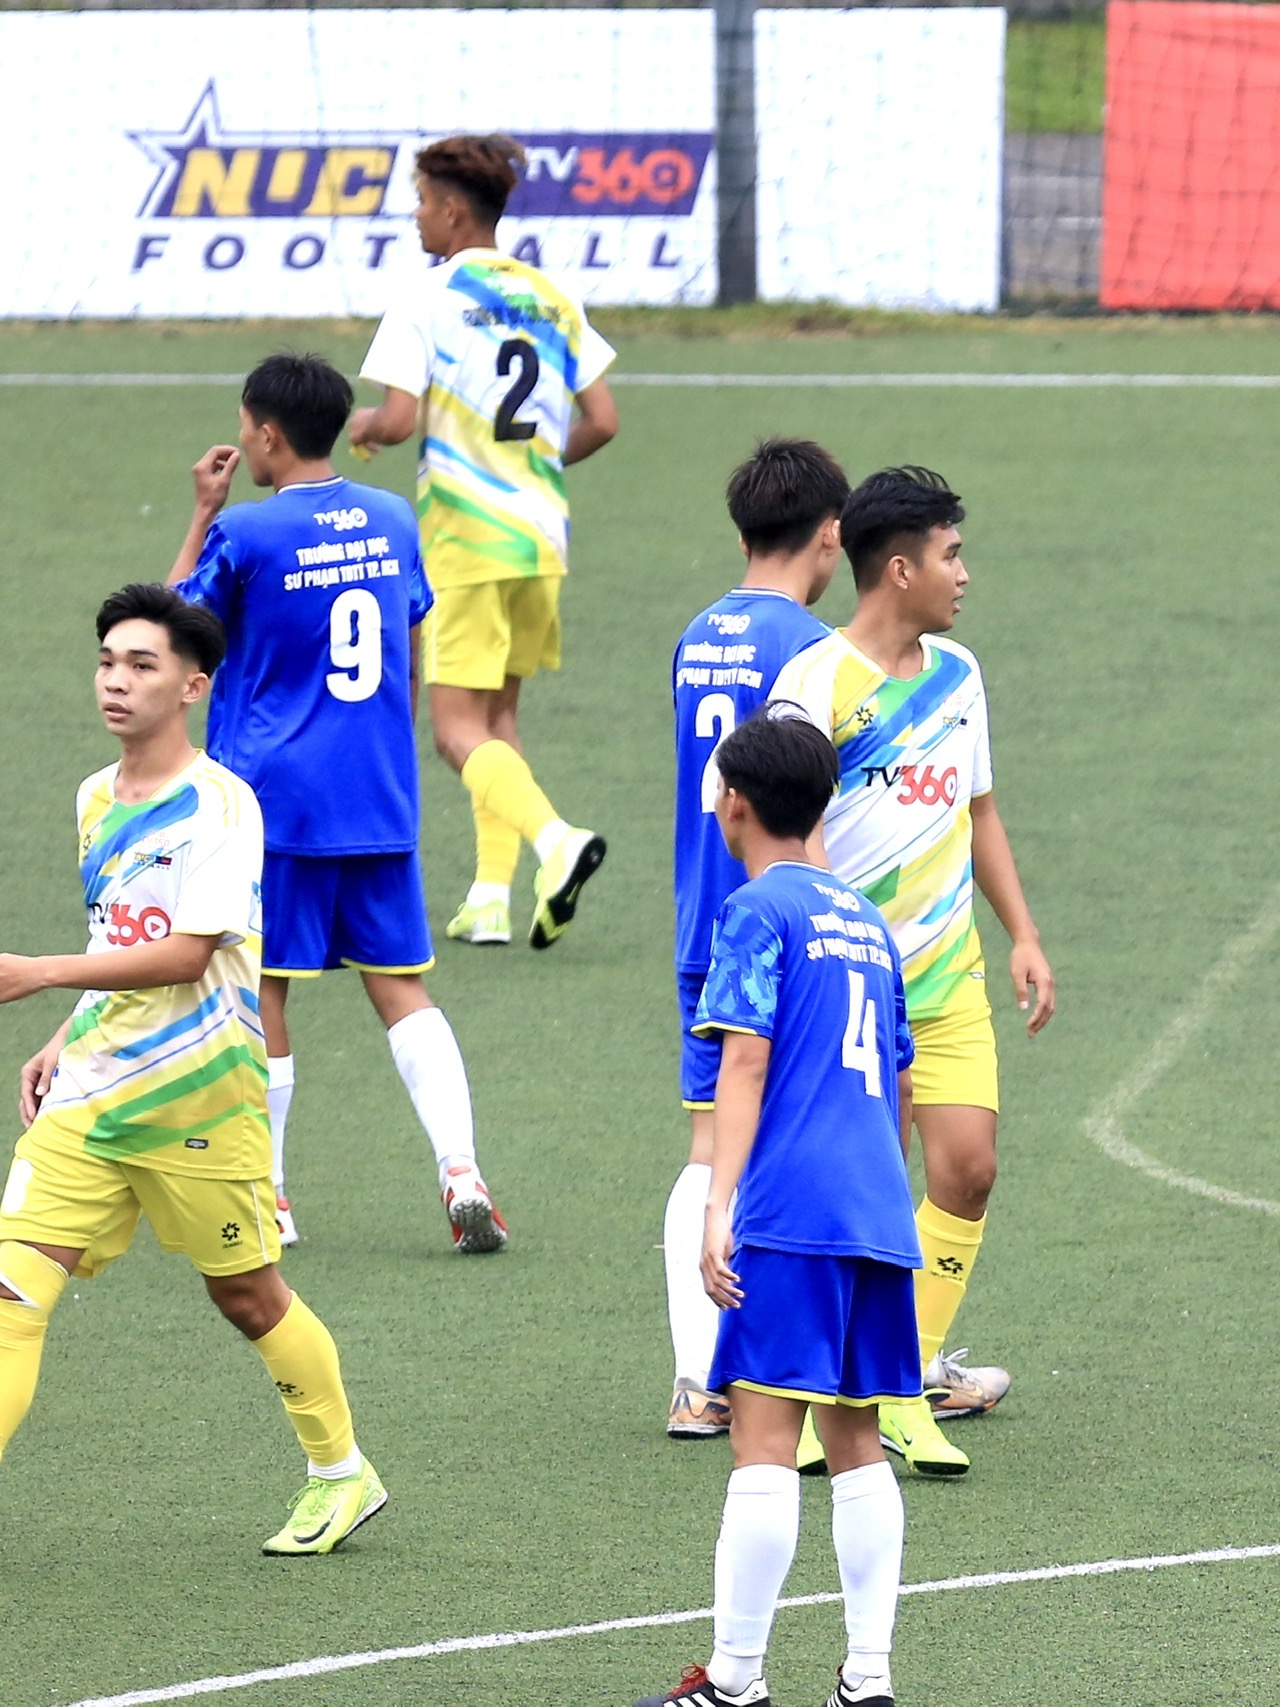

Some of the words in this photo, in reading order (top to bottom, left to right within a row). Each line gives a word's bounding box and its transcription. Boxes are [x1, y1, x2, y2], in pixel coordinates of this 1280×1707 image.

[517, 146, 696, 204] TV360
[131, 233, 679, 269] FOOTALL
[494, 339, 540, 441] 2
[326, 588, 383, 703] 9
[695, 692, 736, 814] 2
[861, 764, 958, 807] TV360
[842, 969, 882, 1098] 4
